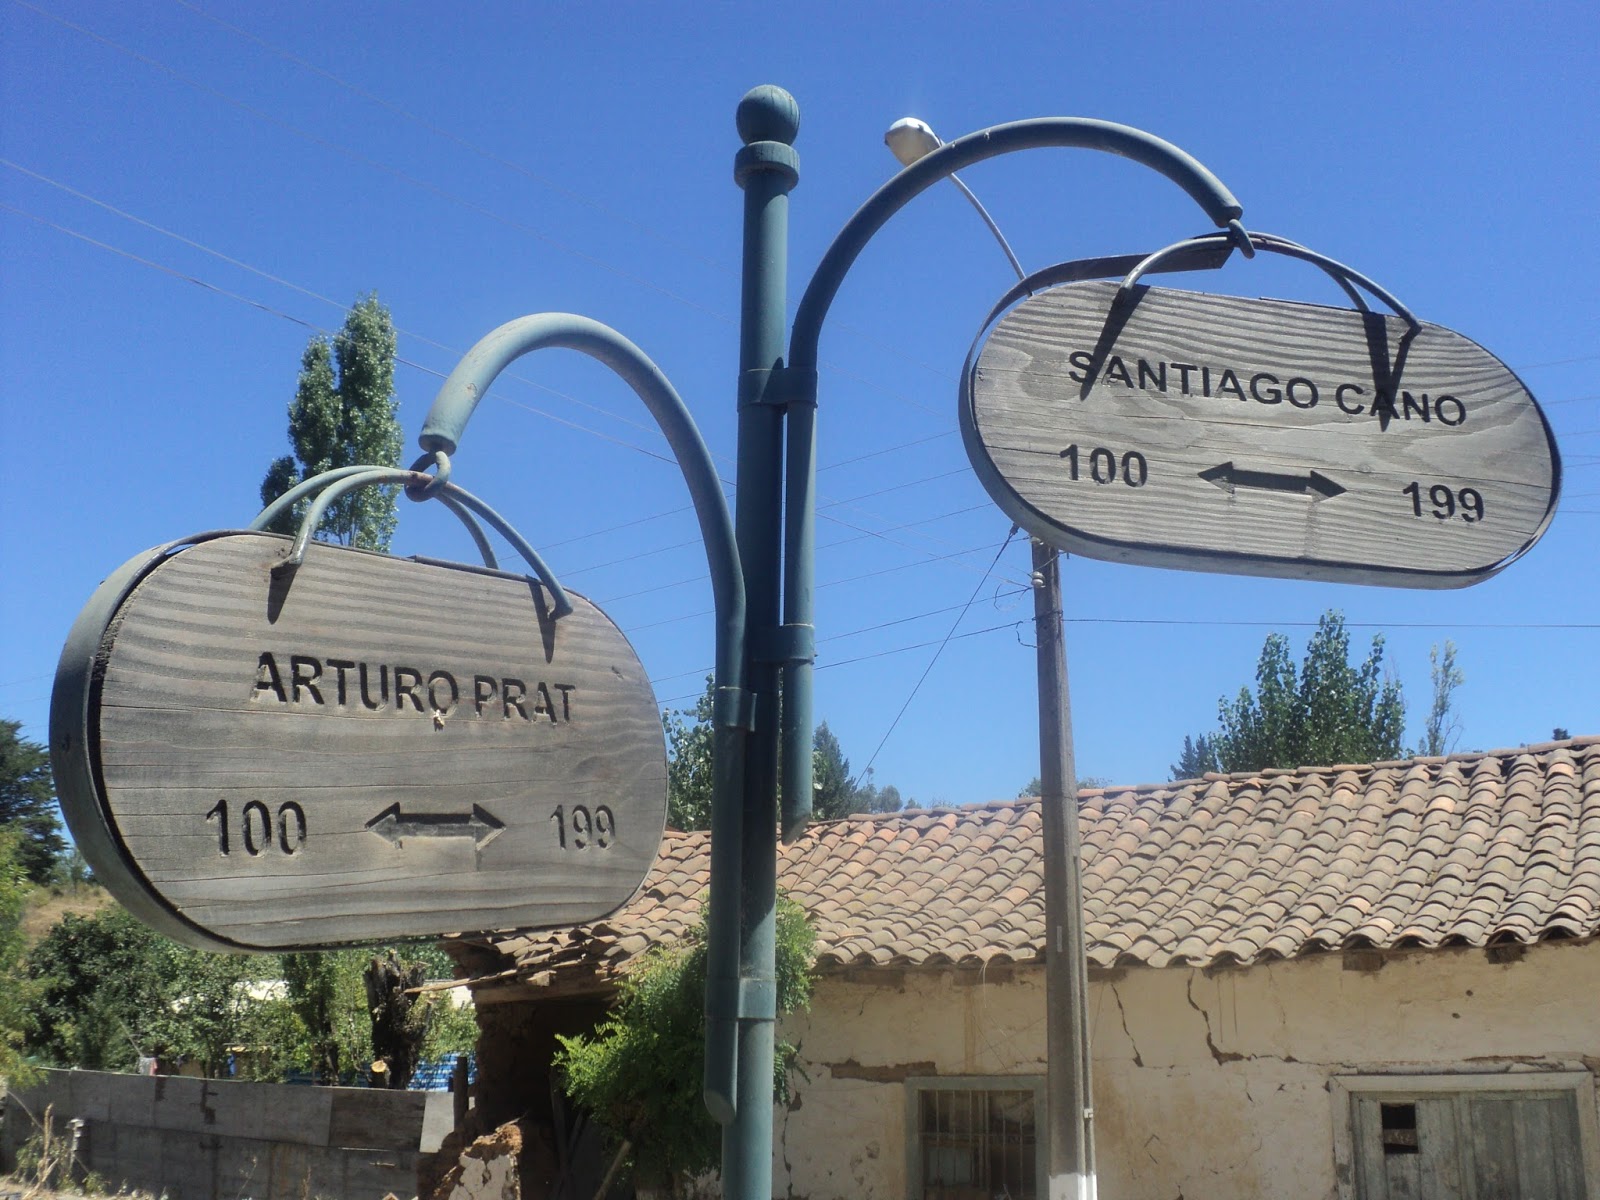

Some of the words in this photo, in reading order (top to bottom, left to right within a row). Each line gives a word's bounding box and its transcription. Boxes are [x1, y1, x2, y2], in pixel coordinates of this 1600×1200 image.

[1069, 350, 1319, 409] SANTIAGO
[1335, 383, 1467, 426] CANO
[1059, 444, 1148, 488] 100
[1402, 481, 1485, 523] 199
[250, 651, 459, 717] ARTURO
[473, 674, 576, 725] PRAT
[205, 799, 307, 857] 100
[549, 803, 616, 851] 199
